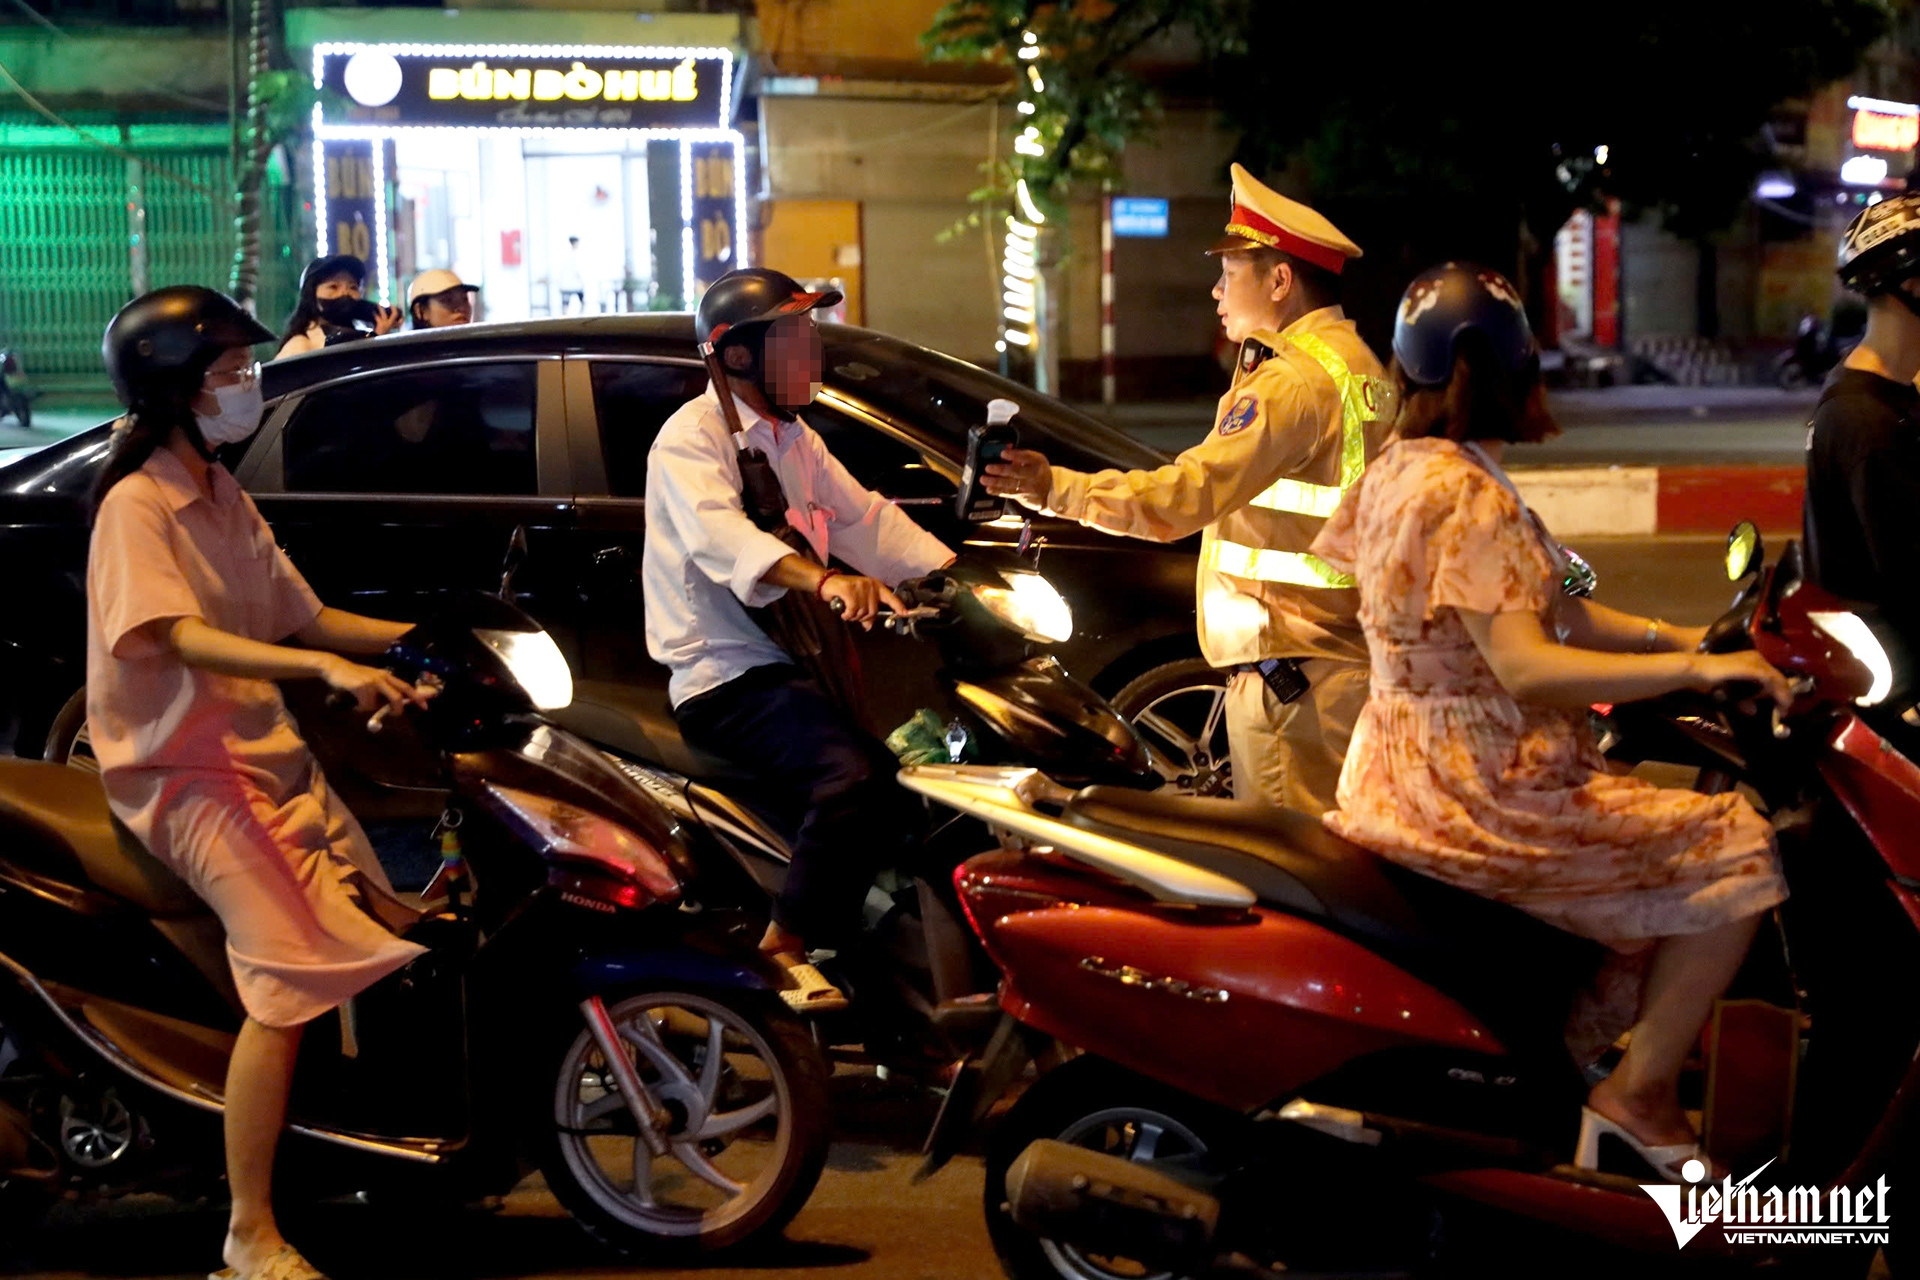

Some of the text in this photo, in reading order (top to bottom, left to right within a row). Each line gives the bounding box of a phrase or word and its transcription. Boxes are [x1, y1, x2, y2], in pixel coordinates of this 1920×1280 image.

[428, 58, 698, 101] BÚN BÒ HUẾ
[561, 891, 617, 914] HONDA
